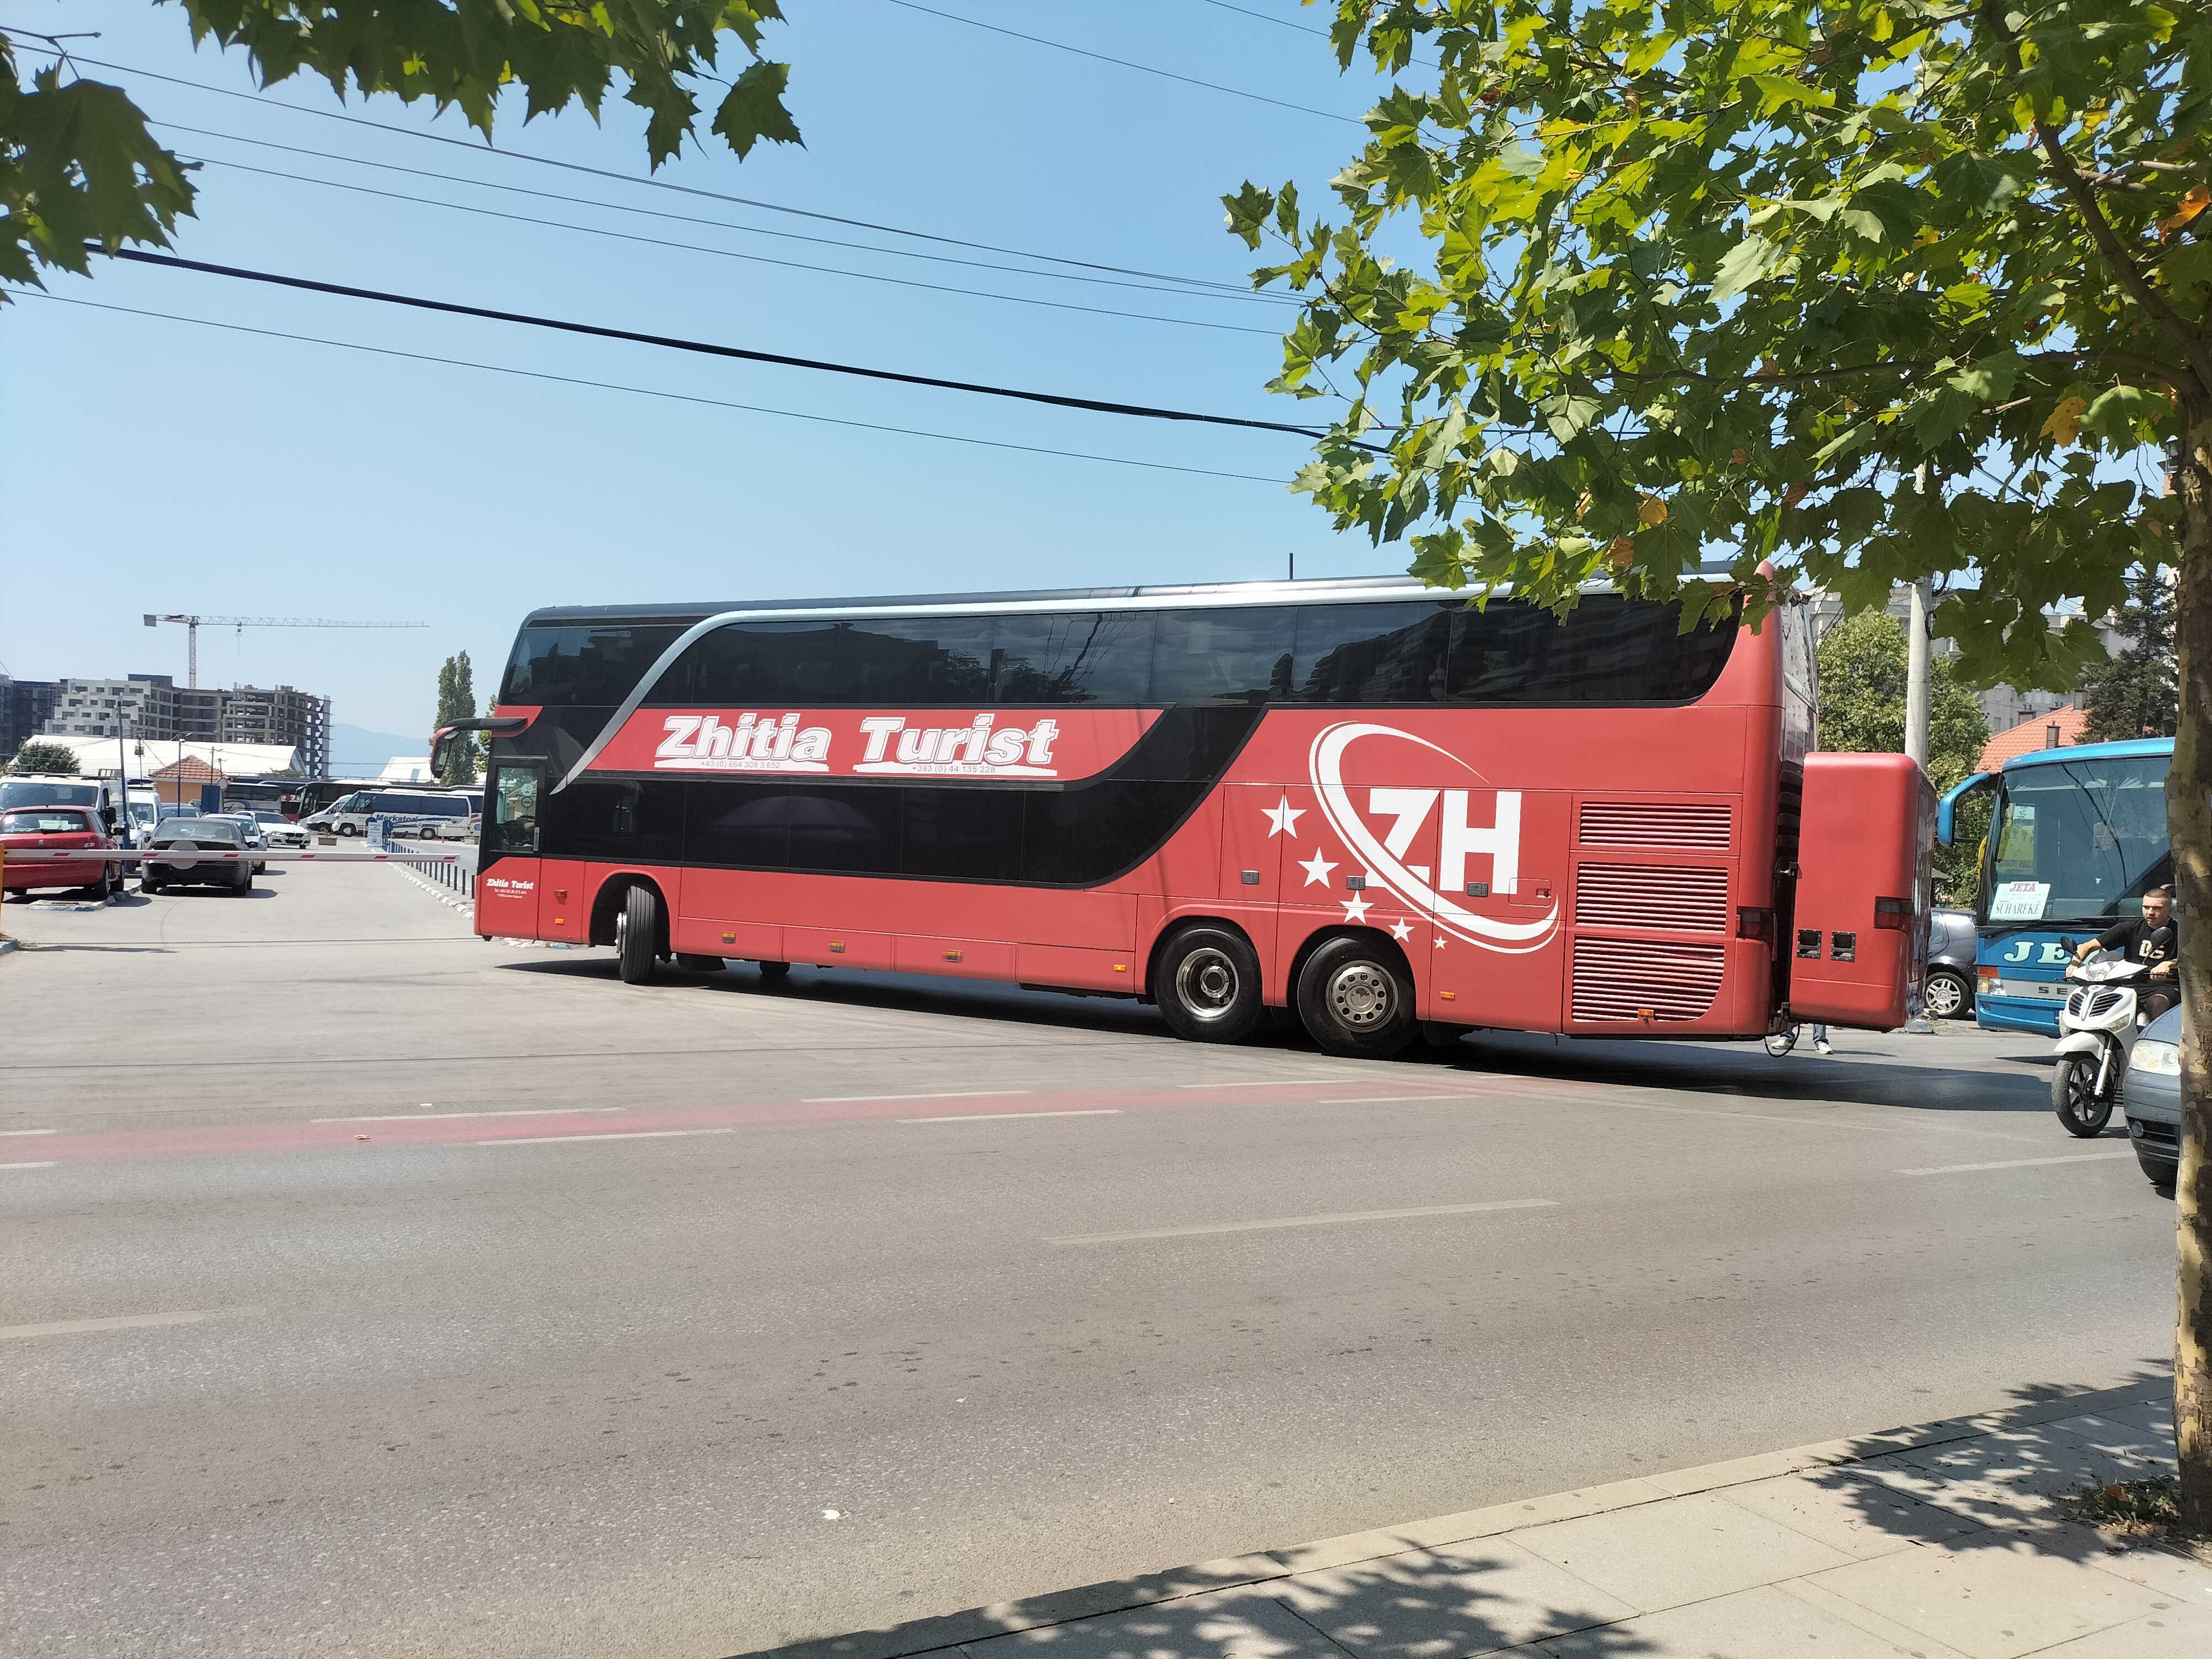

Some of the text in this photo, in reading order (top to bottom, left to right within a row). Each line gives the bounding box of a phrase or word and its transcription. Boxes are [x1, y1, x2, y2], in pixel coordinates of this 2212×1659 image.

[655, 713, 1060, 765] Zhitia Turist
[1364, 788, 1522, 895] ZH
[487, 878, 534, 890] Zhitia Turist
[2010, 883, 2036, 892] JETA
[1995, 901, 2042, 915] SUHAREKË
